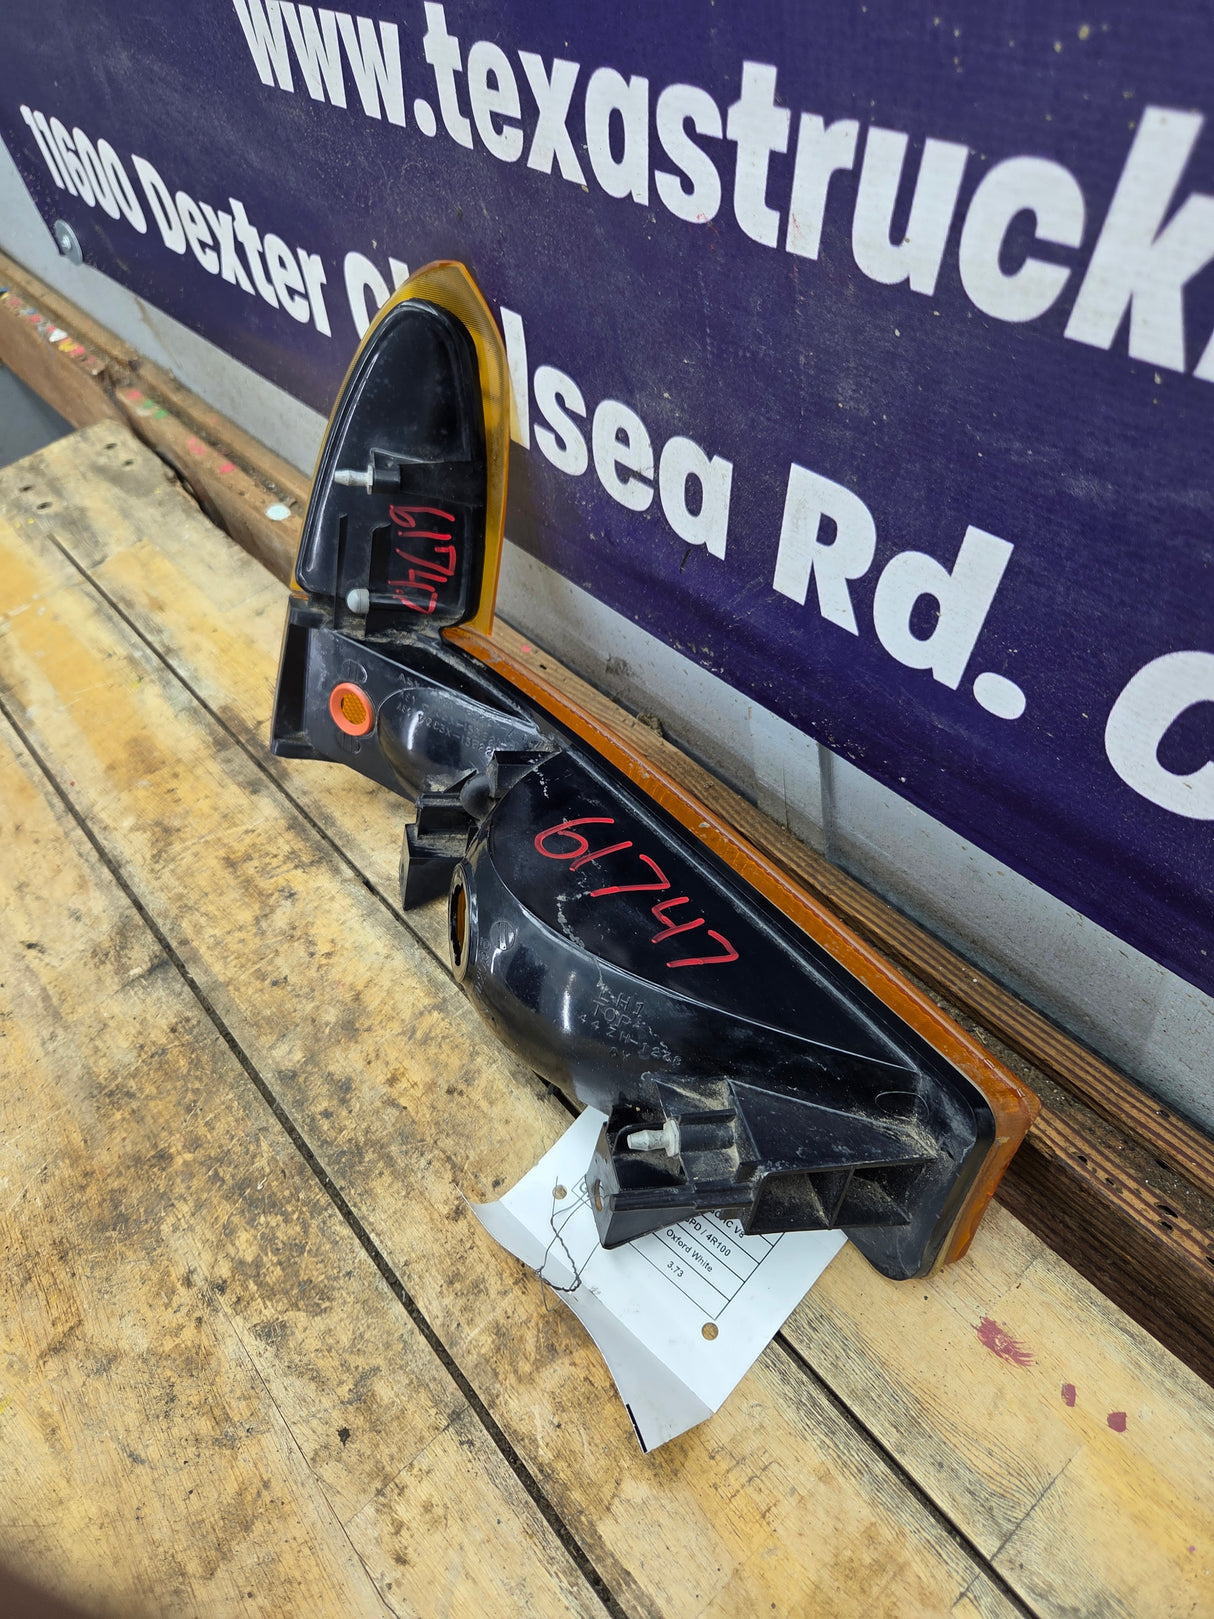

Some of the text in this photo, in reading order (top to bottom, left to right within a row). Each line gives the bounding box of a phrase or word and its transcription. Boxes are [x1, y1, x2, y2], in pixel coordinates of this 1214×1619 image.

[231, 0, 1214, 382] www.texastruck
[20, 105, 147, 234] 11600
[131, 154, 332, 338] Dexter
[499, 306, 734, 561] lsea
[772, 462, 1027, 720] Rd.
[389, 503, 457, 614] 61747
[534, 817, 739, 968] 61747
[666, 1228, 713, 1273] Oxford White
[667, 1260, 684, 1278] 3.73
[706, 1234, 731, 1257] 4R100
